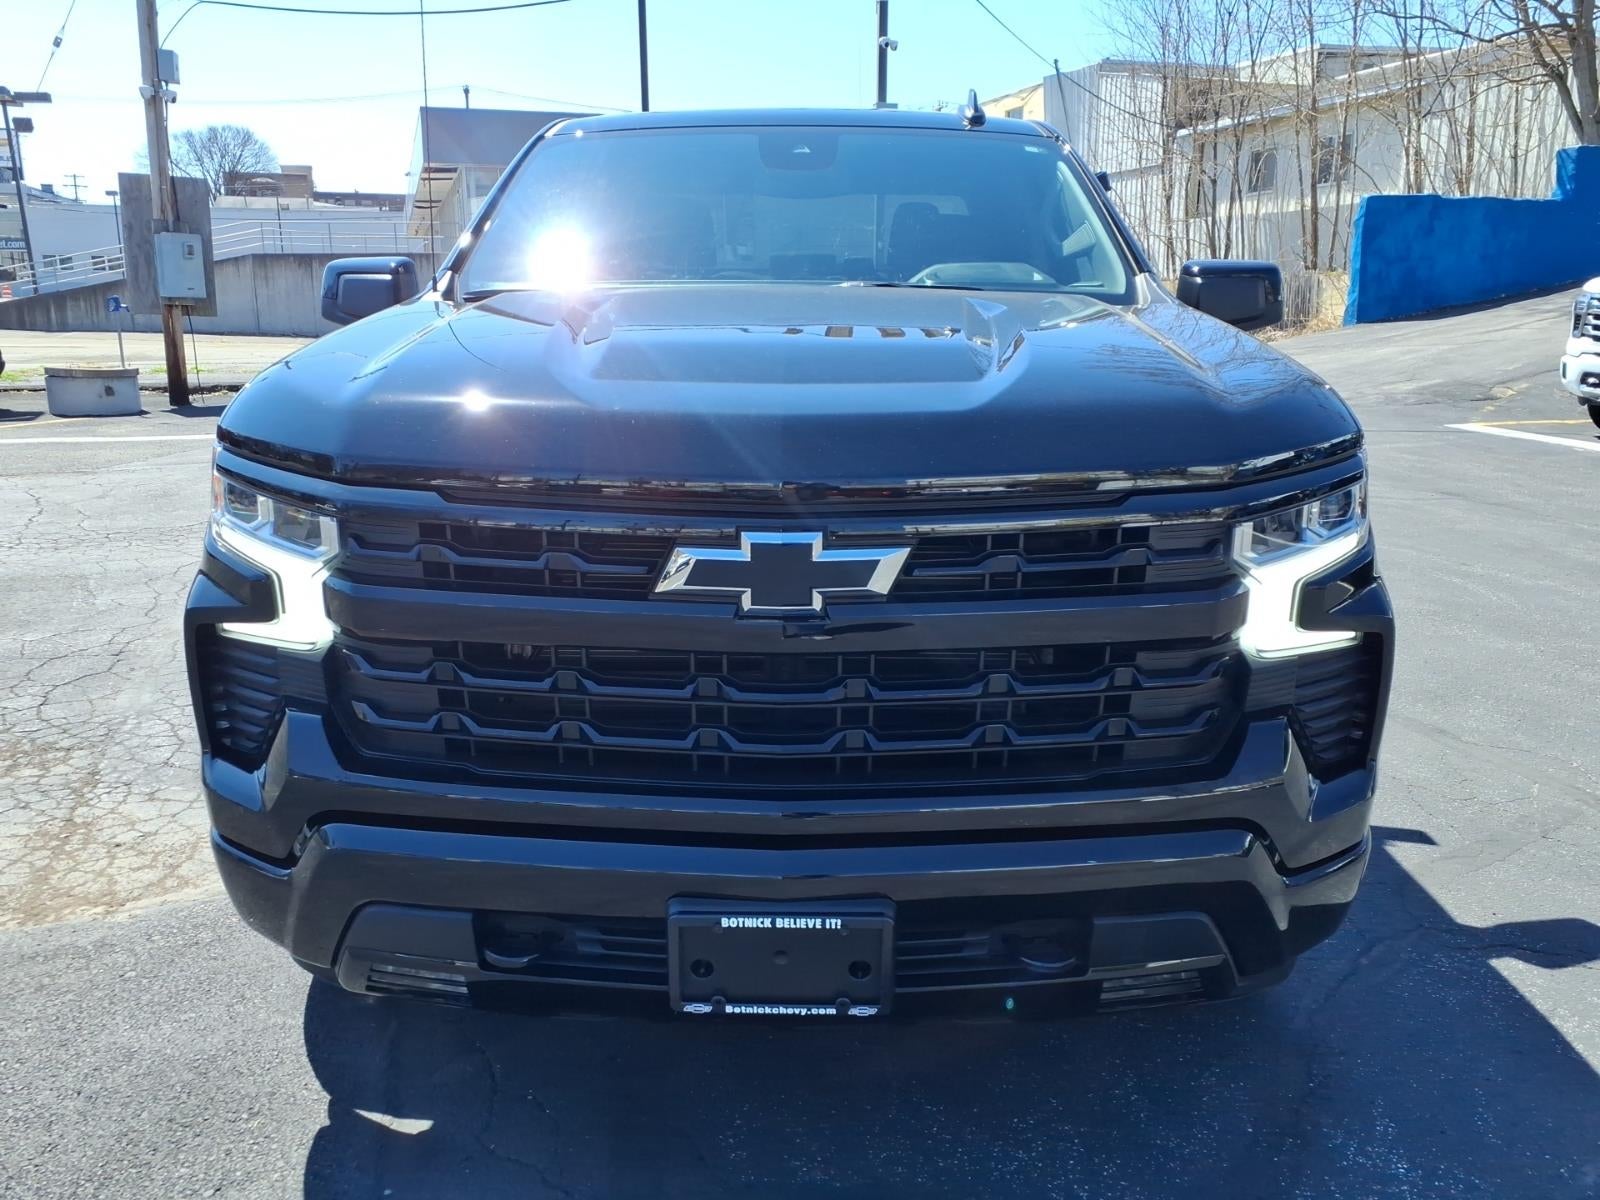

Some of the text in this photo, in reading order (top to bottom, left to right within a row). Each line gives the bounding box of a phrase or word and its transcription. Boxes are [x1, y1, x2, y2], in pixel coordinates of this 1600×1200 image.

[720, 917, 842, 929] BOTNICK BELIEVE IT!
